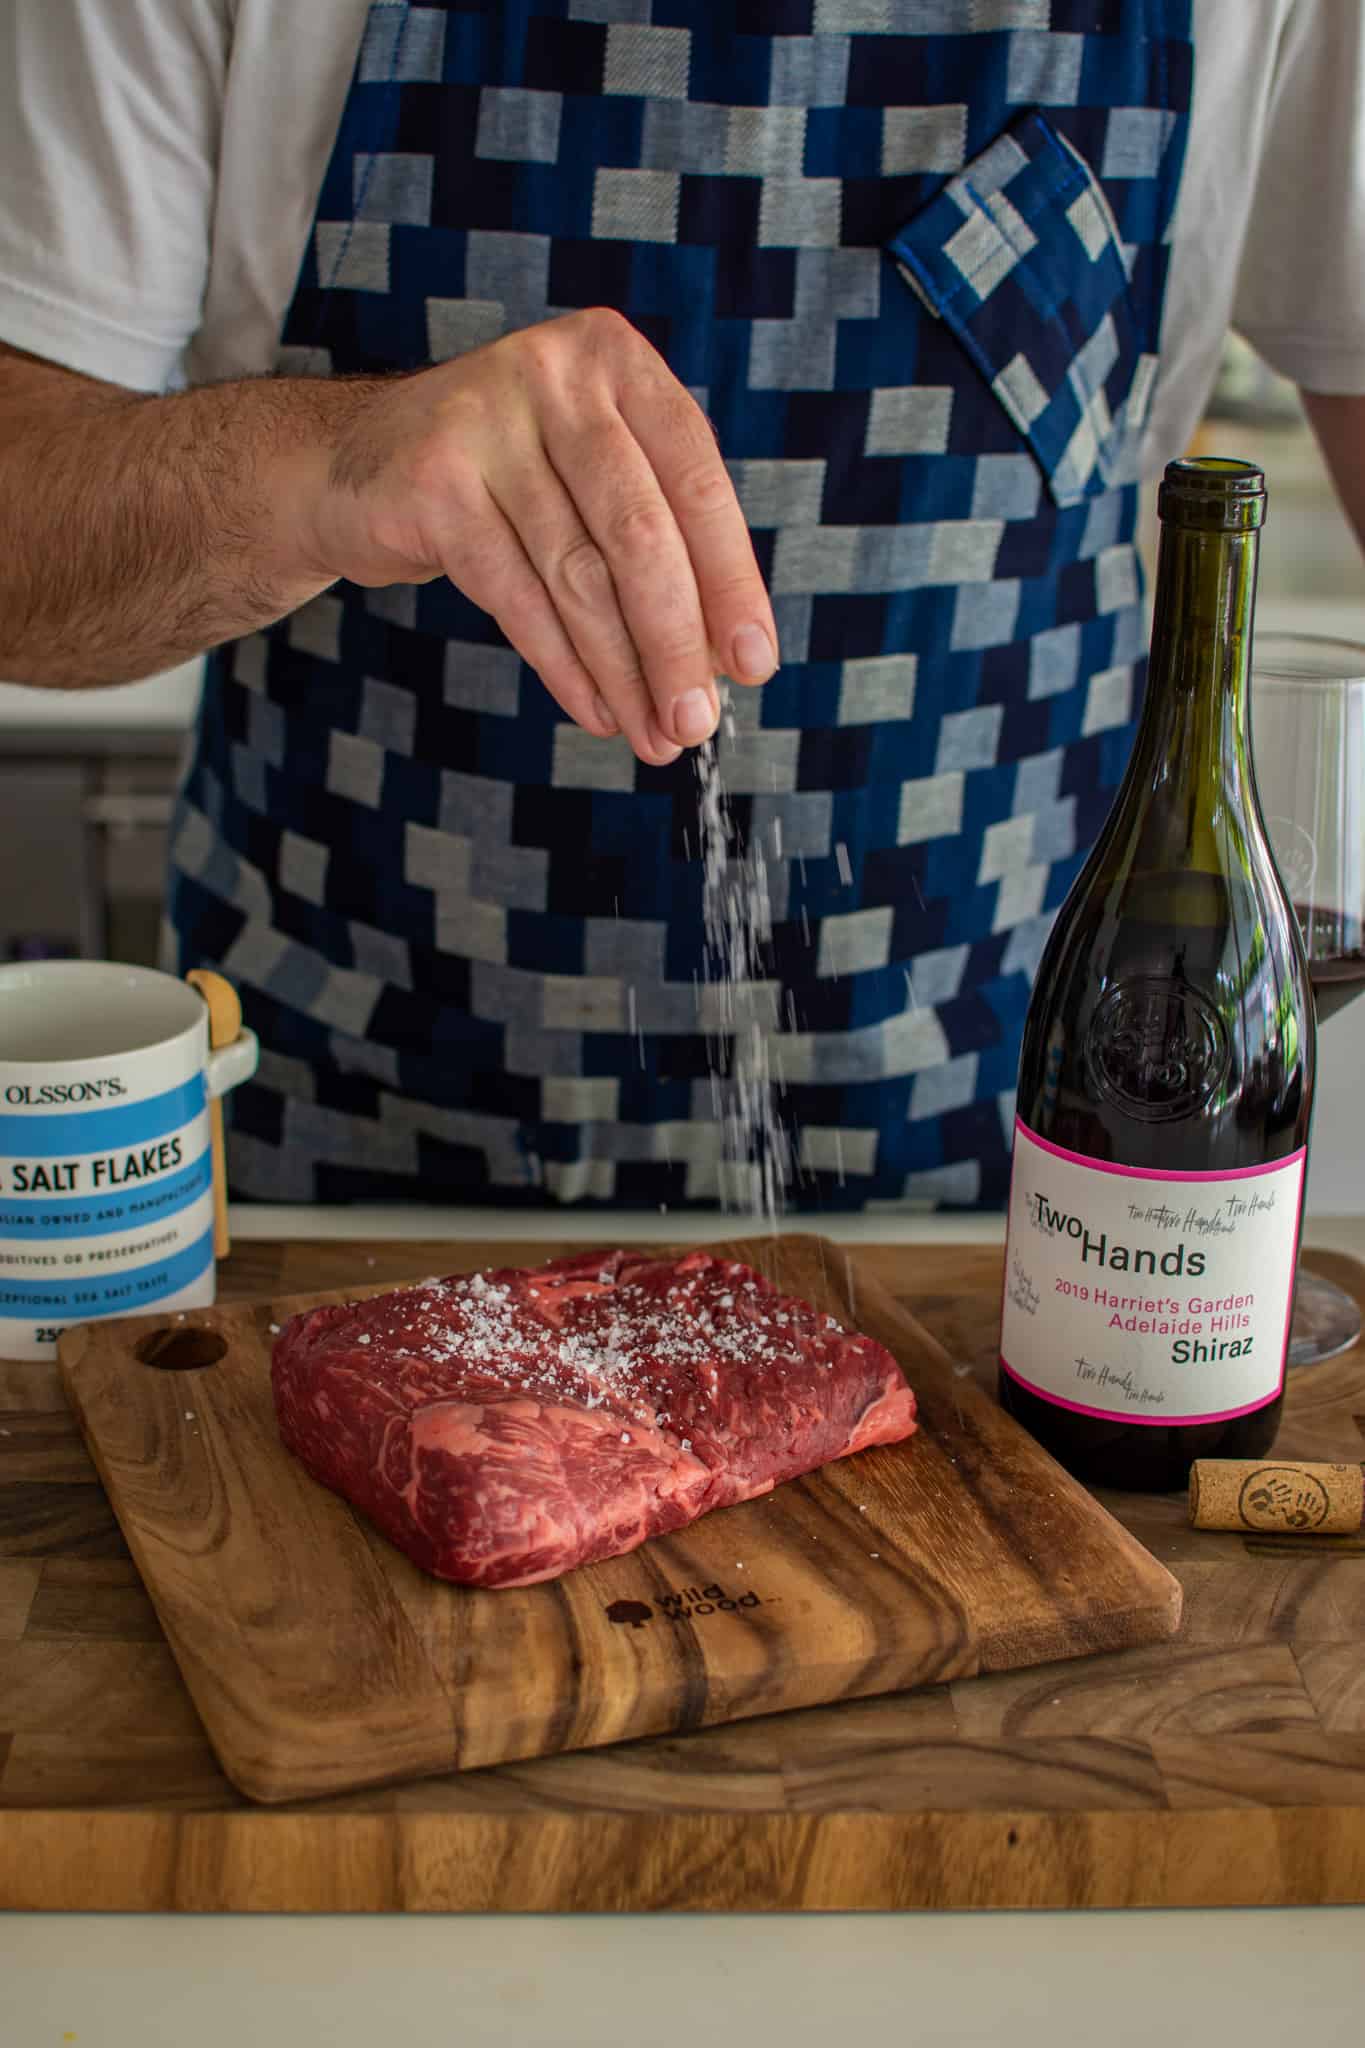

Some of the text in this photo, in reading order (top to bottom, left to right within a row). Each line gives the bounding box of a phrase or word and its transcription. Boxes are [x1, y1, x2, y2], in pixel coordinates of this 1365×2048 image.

[12, 1137, 182, 1192] SALT FLAKES
[40, 1212, 90, 1226] OWNED
[96, 1207, 124, 1221] AND
[1034, 1192, 1084, 1239] Two
[63, 1253, 83, 1265] OR
[1081, 1230, 1206, 1277] Hands
[104, 1284, 132, 1300] SALT
[1055, 1278, 1254, 1315] 2019 Harriet's Garden
[1108, 1313, 1250, 1336] Adelaide Hills
[1170, 1336, 1254, 1365] Shiraz
[655, 1584, 726, 1607] wild
[664, 1592, 761, 1620] wood
